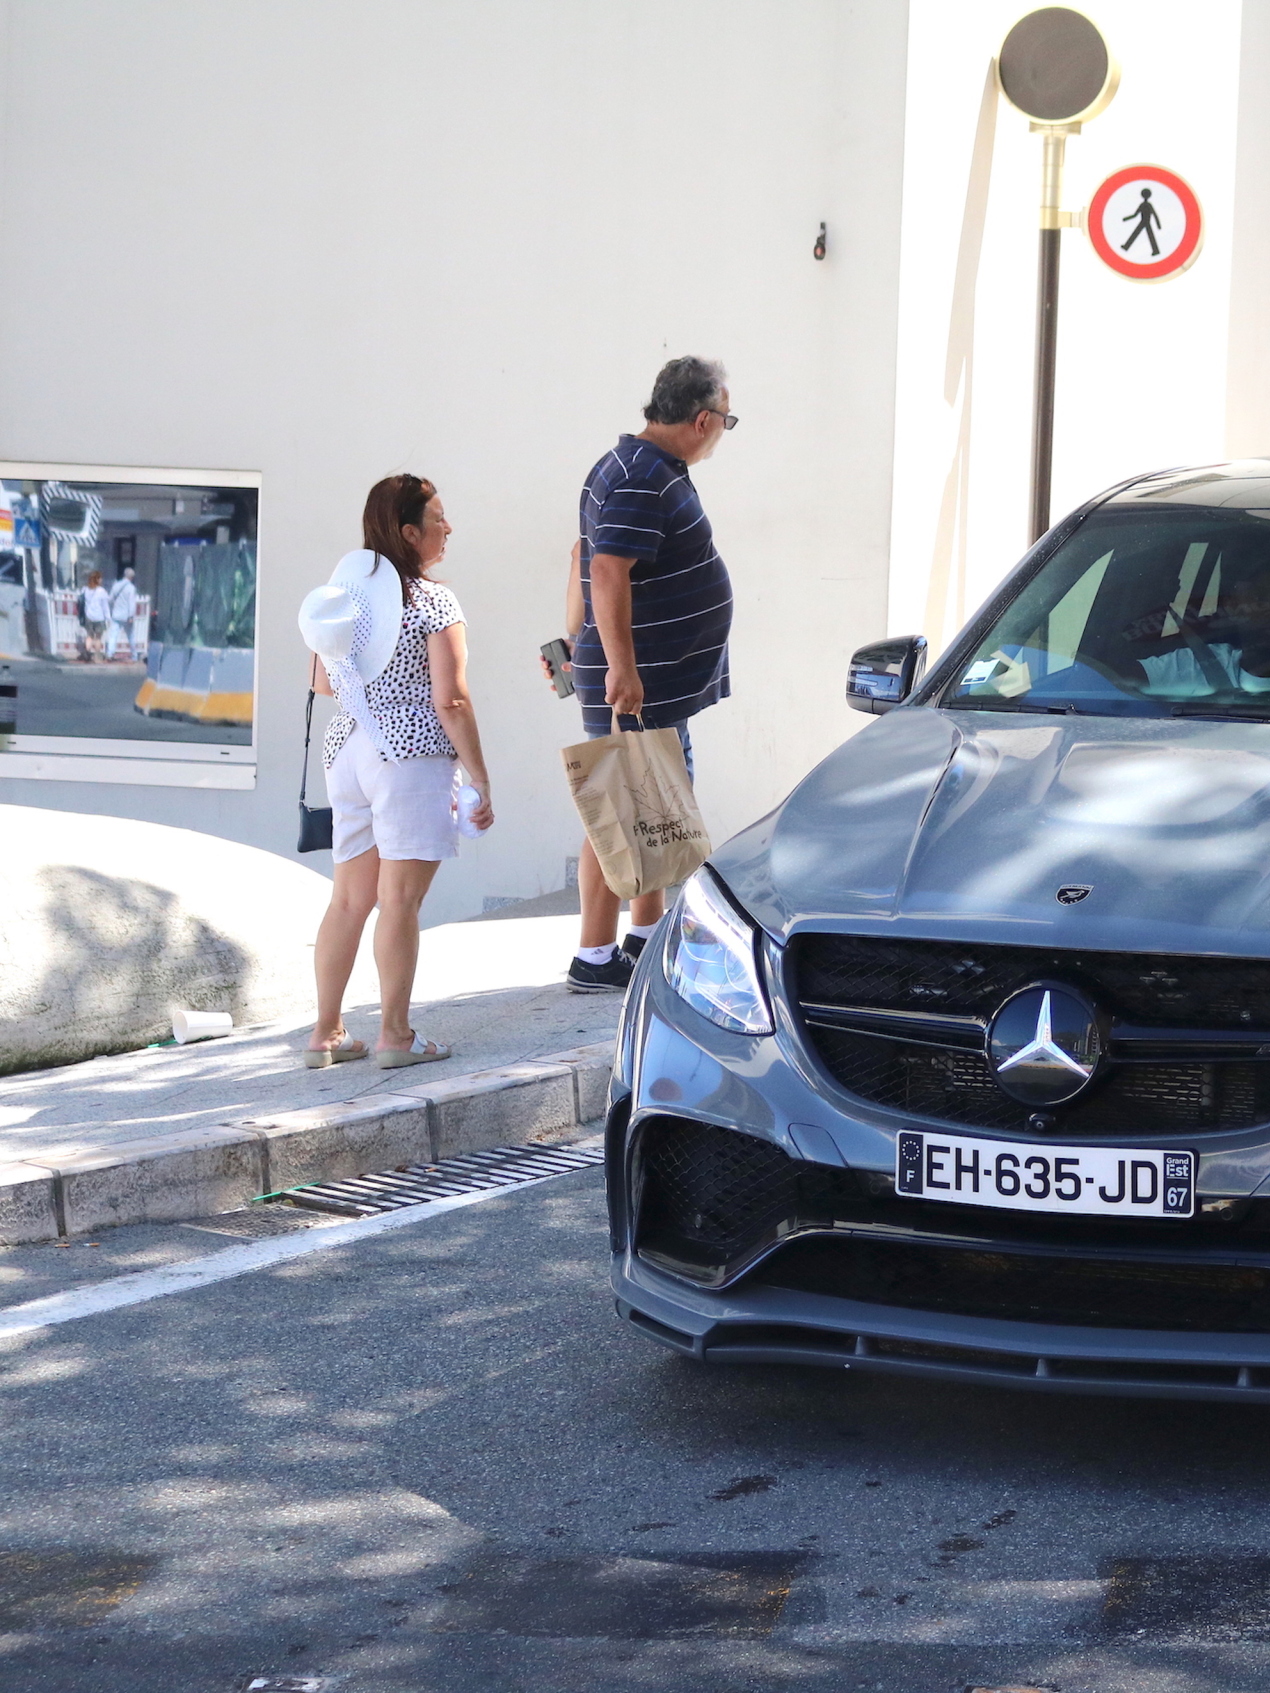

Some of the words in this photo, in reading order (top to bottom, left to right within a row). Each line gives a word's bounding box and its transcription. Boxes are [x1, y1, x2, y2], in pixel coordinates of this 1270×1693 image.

[646, 837, 658, 847] de
[660, 835, 669, 846] la
[671, 829, 702, 842] Nature
[1166, 1157, 1189, 1165] Grand
[905, 1169, 915, 1183] F
[926, 1144, 1159, 1205] EH-635-JD
[1166, 1164, 1189, 1177] Est
[1167, 1187, 1188, 1207] 67
